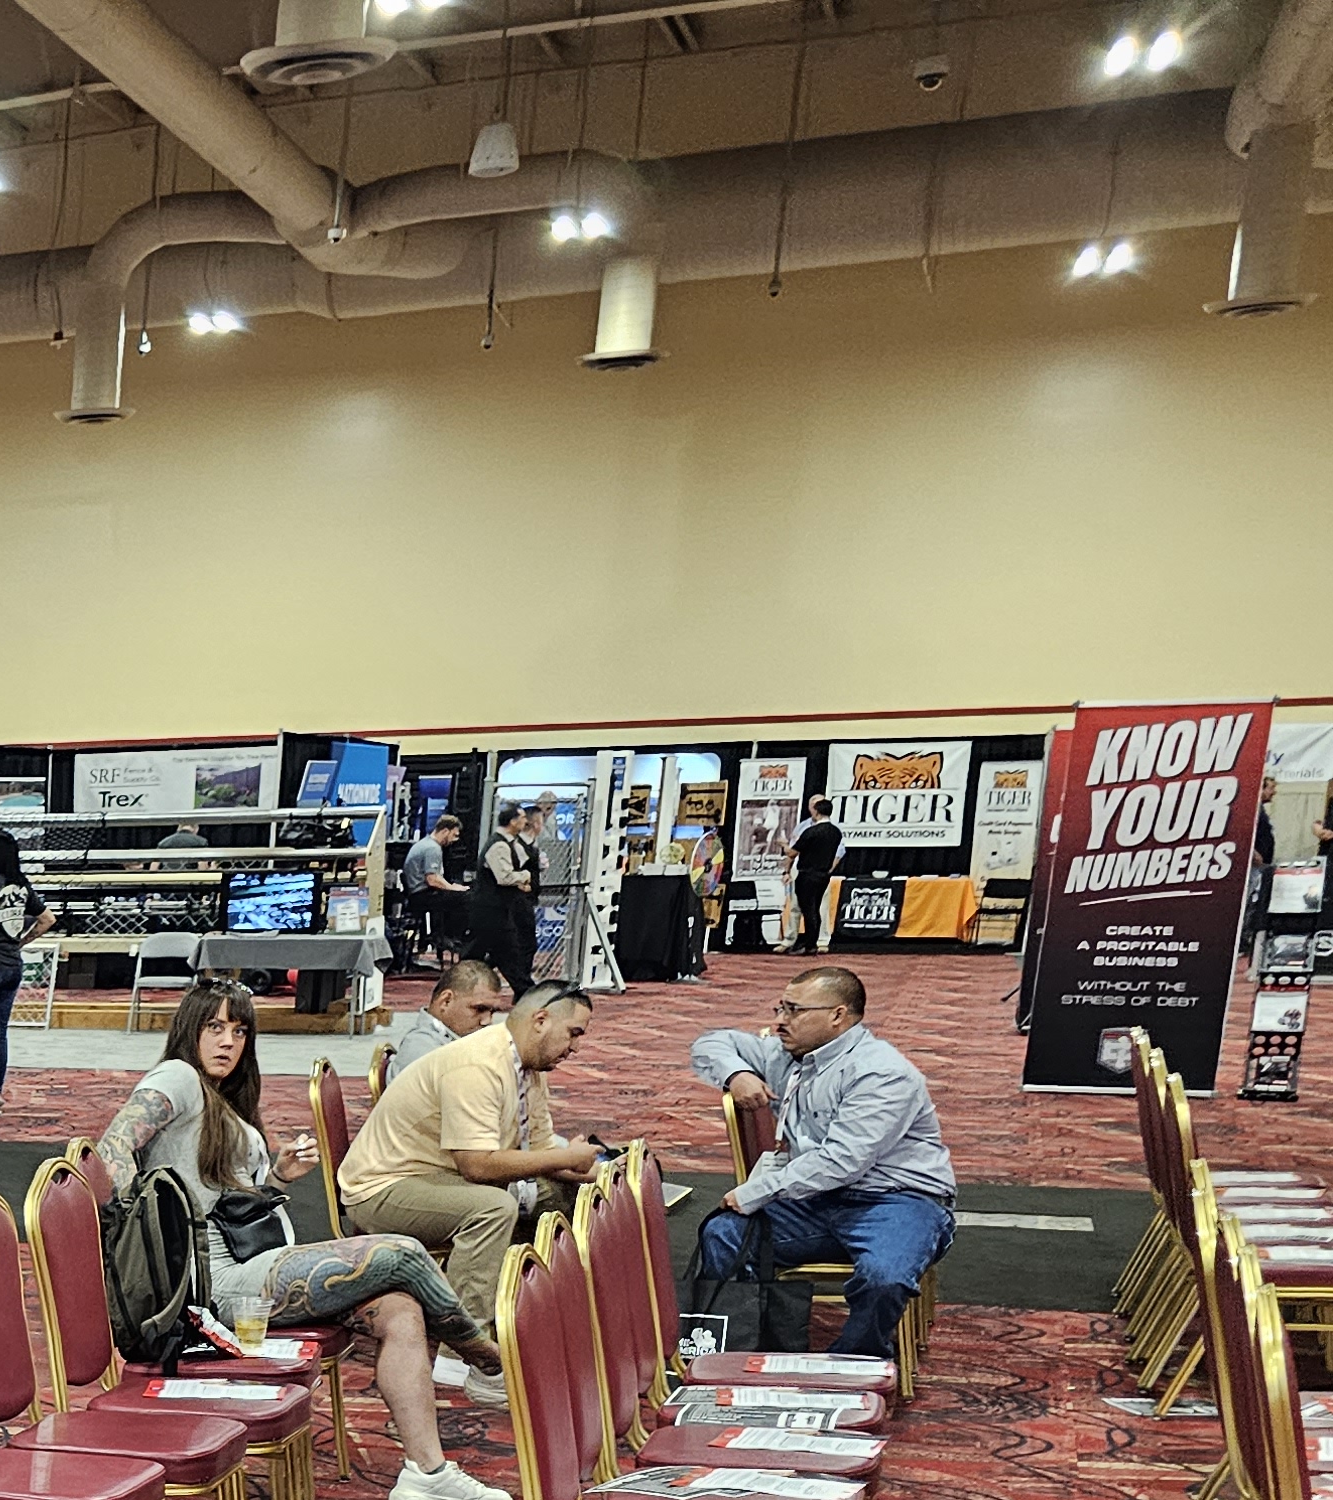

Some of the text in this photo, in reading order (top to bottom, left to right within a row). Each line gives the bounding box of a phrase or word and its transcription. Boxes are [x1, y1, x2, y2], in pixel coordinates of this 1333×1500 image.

[1085, 712, 1254, 788] KNOW
[89, 768, 121, 784] SRF
[751, 779, 793, 792] TIGER
[98, 791, 145, 808] Trex
[985, 789, 1031, 806] TIGER
[831, 793, 955, 824] TIGER
[1086, 776, 1239, 851] YOUR
[842, 830, 946, 839] AYMENT SOLUTIONS
[1064, 841, 1236, 894] NUMBERS
[843, 904, 896, 920] TIGER
[1106, 925, 1175, 936] CREATE
[1076, 940, 1200, 952] A PROFITABLE
[1093, 956, 1179, 967] BUSINESS
[1077, 980, 1187, 992] WITHOUT THE
[1061, 994, 1200, 1007] STRESS OF DEBT
